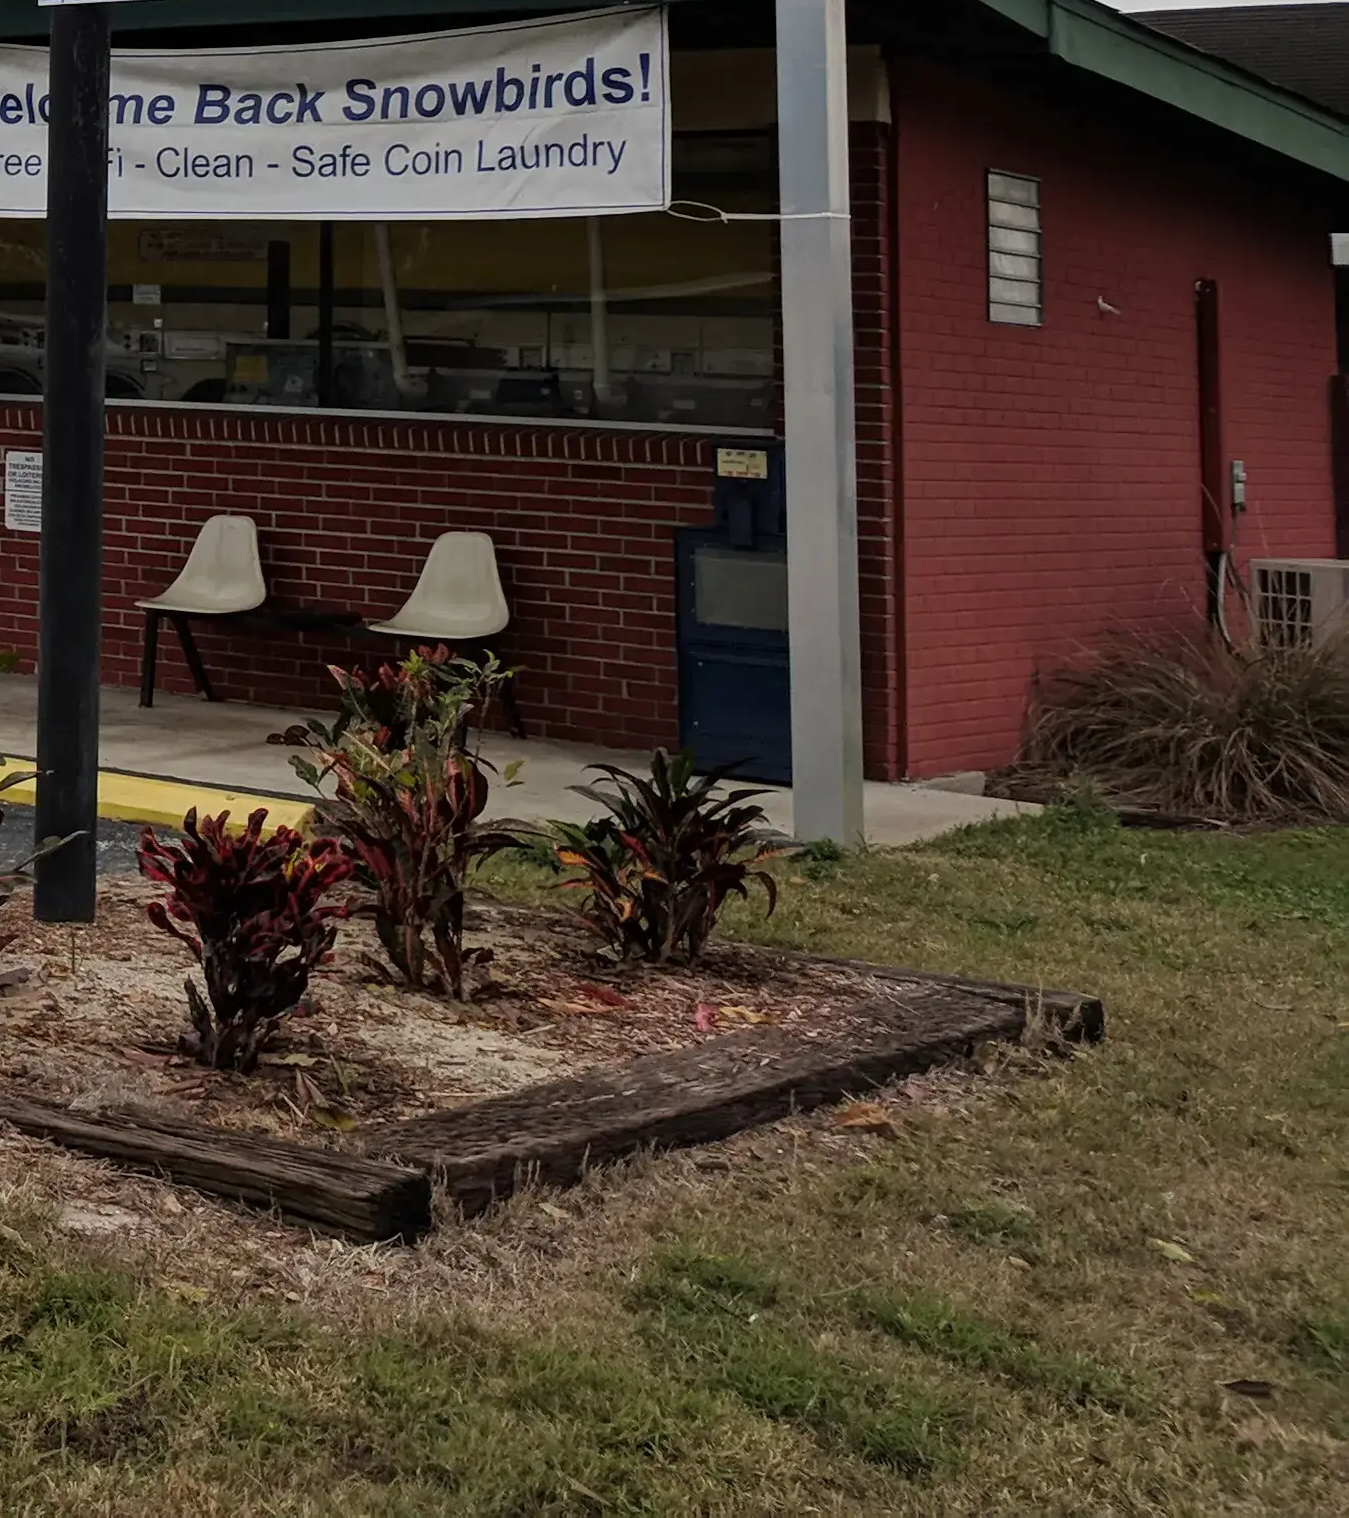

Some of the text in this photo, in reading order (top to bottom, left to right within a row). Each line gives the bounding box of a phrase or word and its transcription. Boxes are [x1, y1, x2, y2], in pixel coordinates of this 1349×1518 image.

[194, 82, 325, 125] Back
[342, 52, 651, 121] Snowbirds!
[156, 146, 253, 178] Clean
[292, 144, 372, 178] Safe
[384, 142, 463, 176] Coin
[476, 133, 628, 175] Laundry
